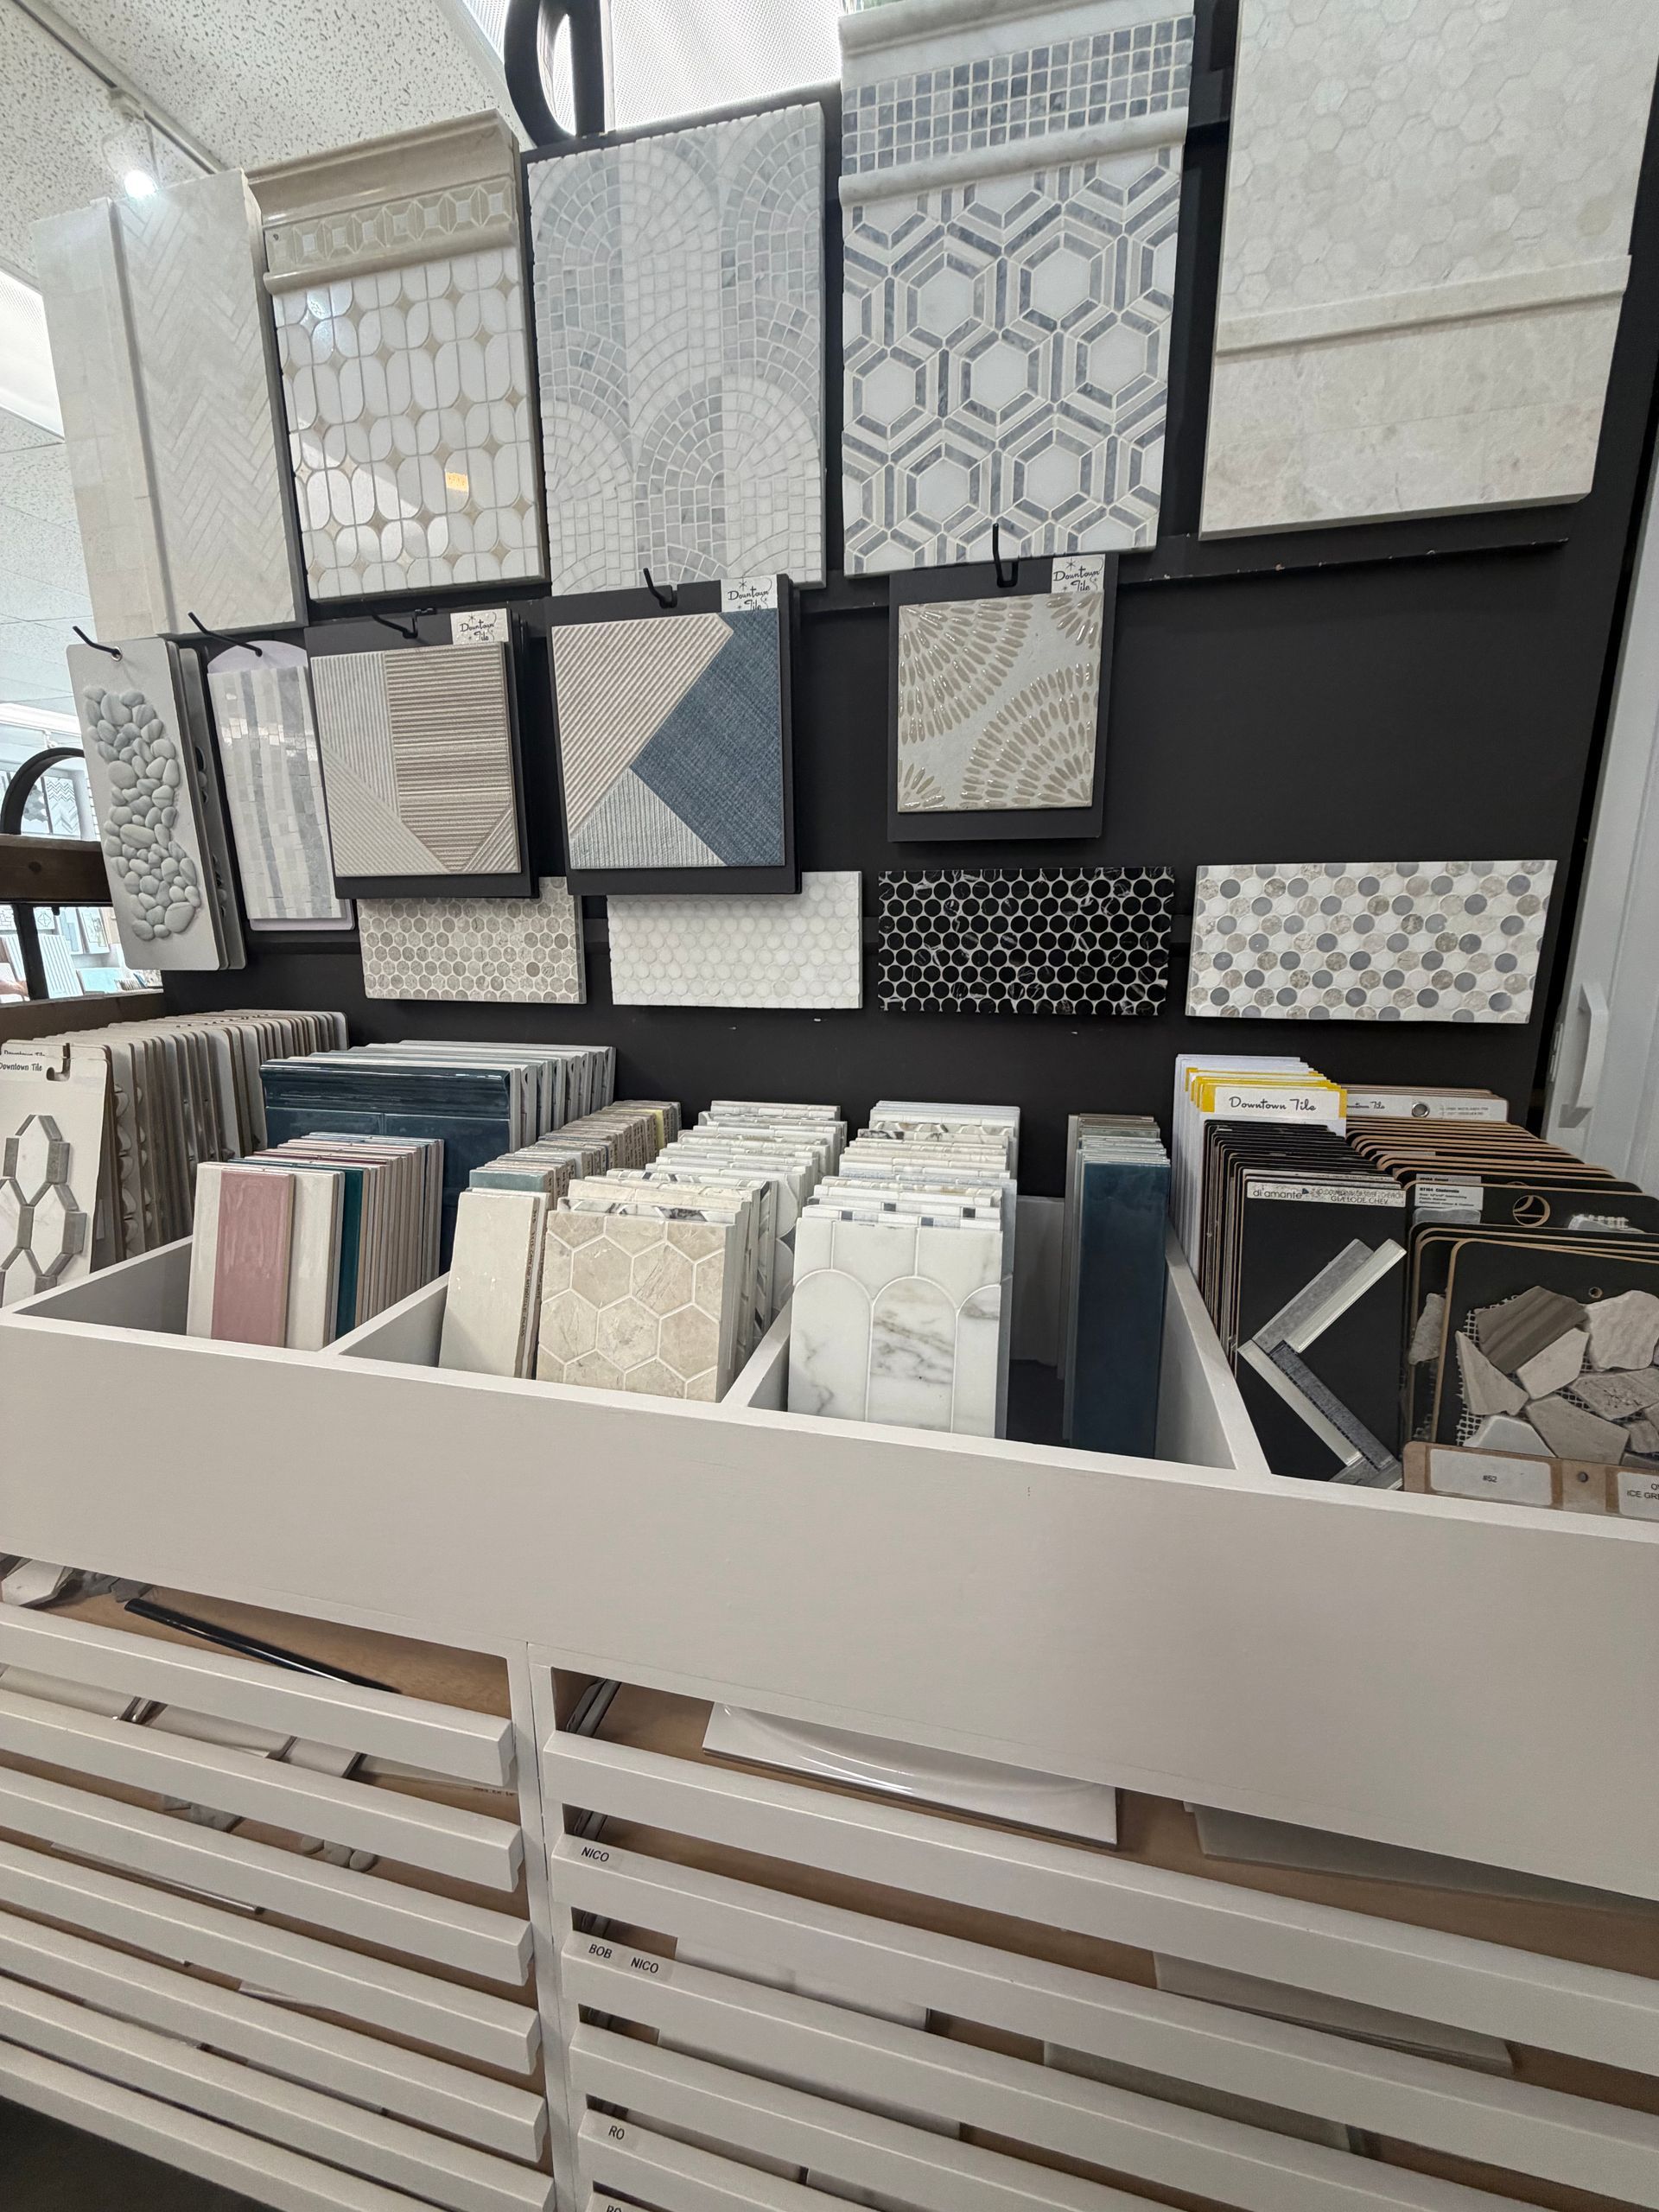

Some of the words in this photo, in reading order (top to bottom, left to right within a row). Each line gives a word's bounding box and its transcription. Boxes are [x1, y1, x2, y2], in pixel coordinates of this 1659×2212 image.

[31, 1063, 43, 1072] Tile
[1229, 1096, 1287, 1110] Downtown
[1289, 1098, 1317, 1111] Tile
[581, 1847, 609, 1862] NICO
[588, 1943, 613, 1959] BOB
[631, 1956, 658, 1974] NICO
[608, 2125, 625, 2140] RO
